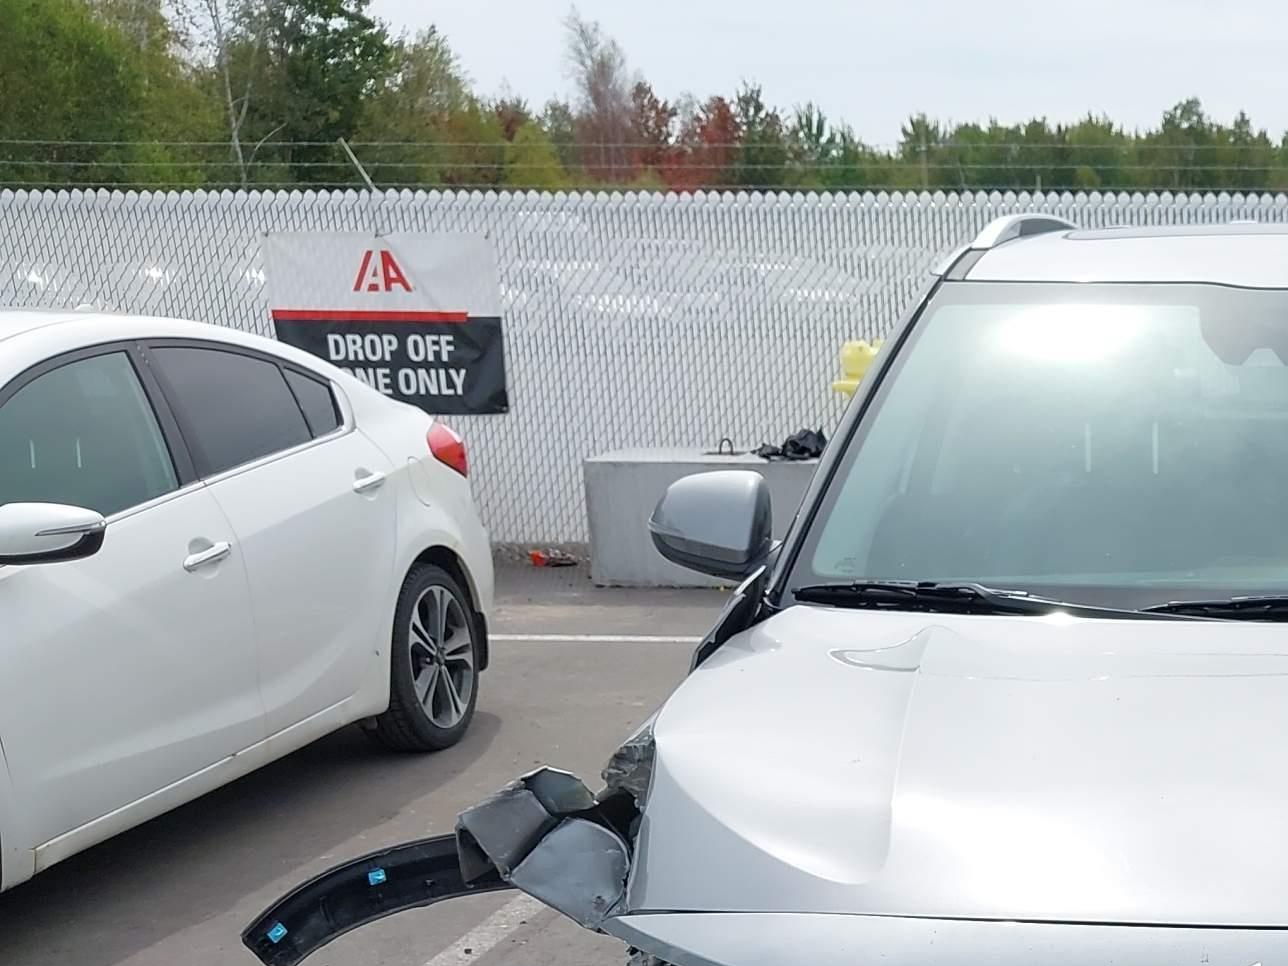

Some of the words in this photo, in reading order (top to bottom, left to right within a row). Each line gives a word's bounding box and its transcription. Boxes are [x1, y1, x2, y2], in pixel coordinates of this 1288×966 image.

[327, 333, 399, 362] DROP
[406, 334, 455, 362] OFF
[398, 367, 467, 396] ONLY
